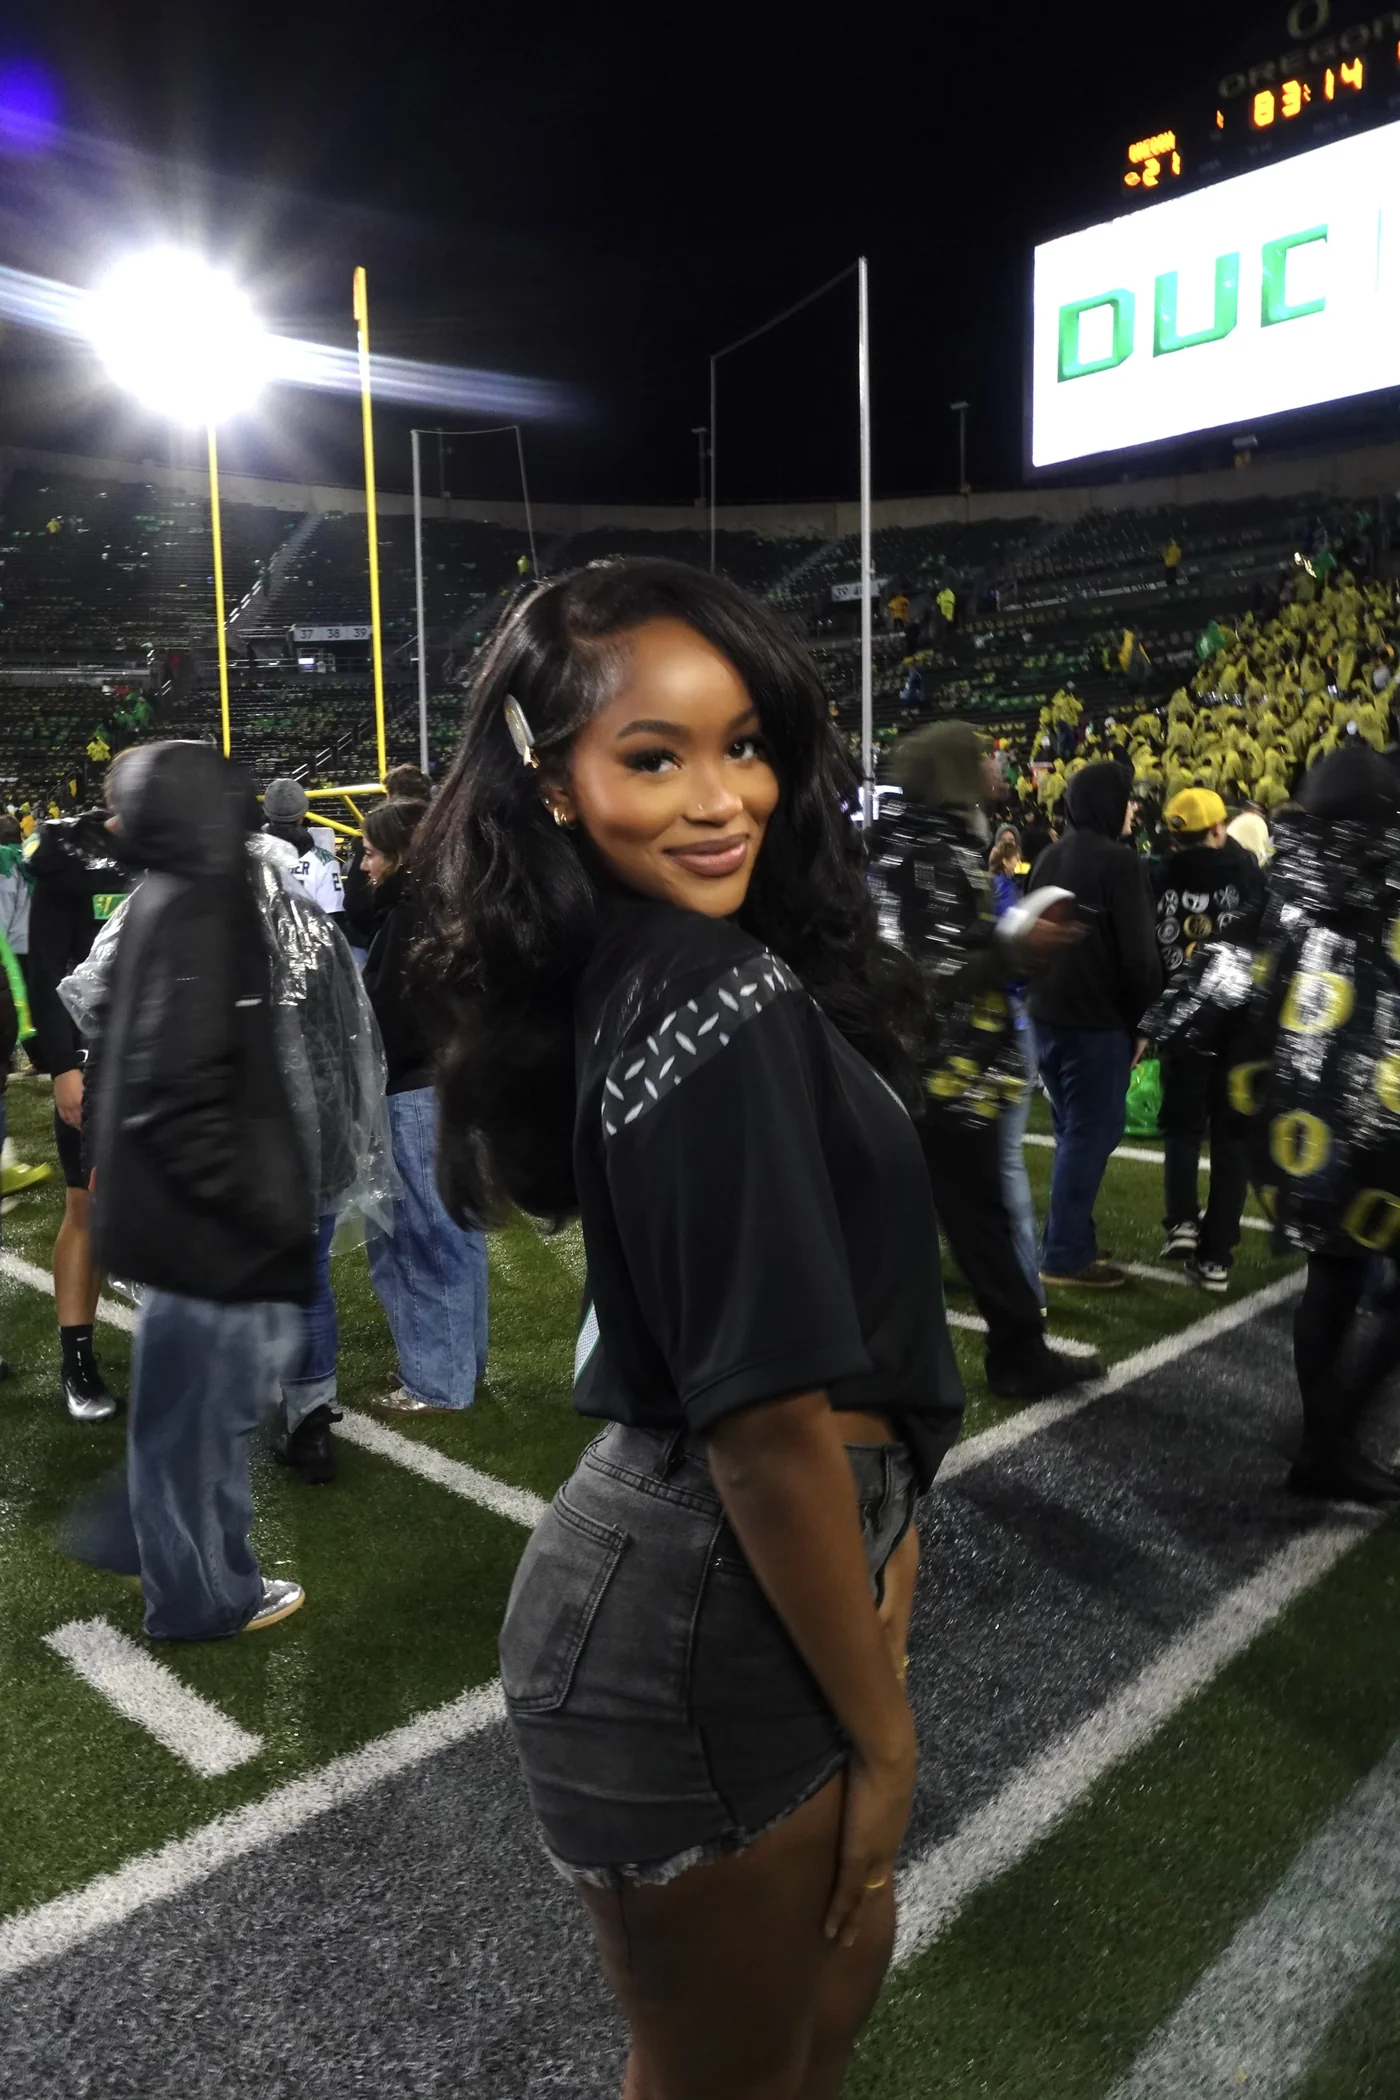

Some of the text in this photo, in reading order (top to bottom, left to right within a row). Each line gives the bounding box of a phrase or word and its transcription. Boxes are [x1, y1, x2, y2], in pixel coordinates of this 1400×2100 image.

[1057, 205, 1382, 385] DUC
[300, 627, 367, 640] 37 38 39
[290, 861, 310, 875] ER
